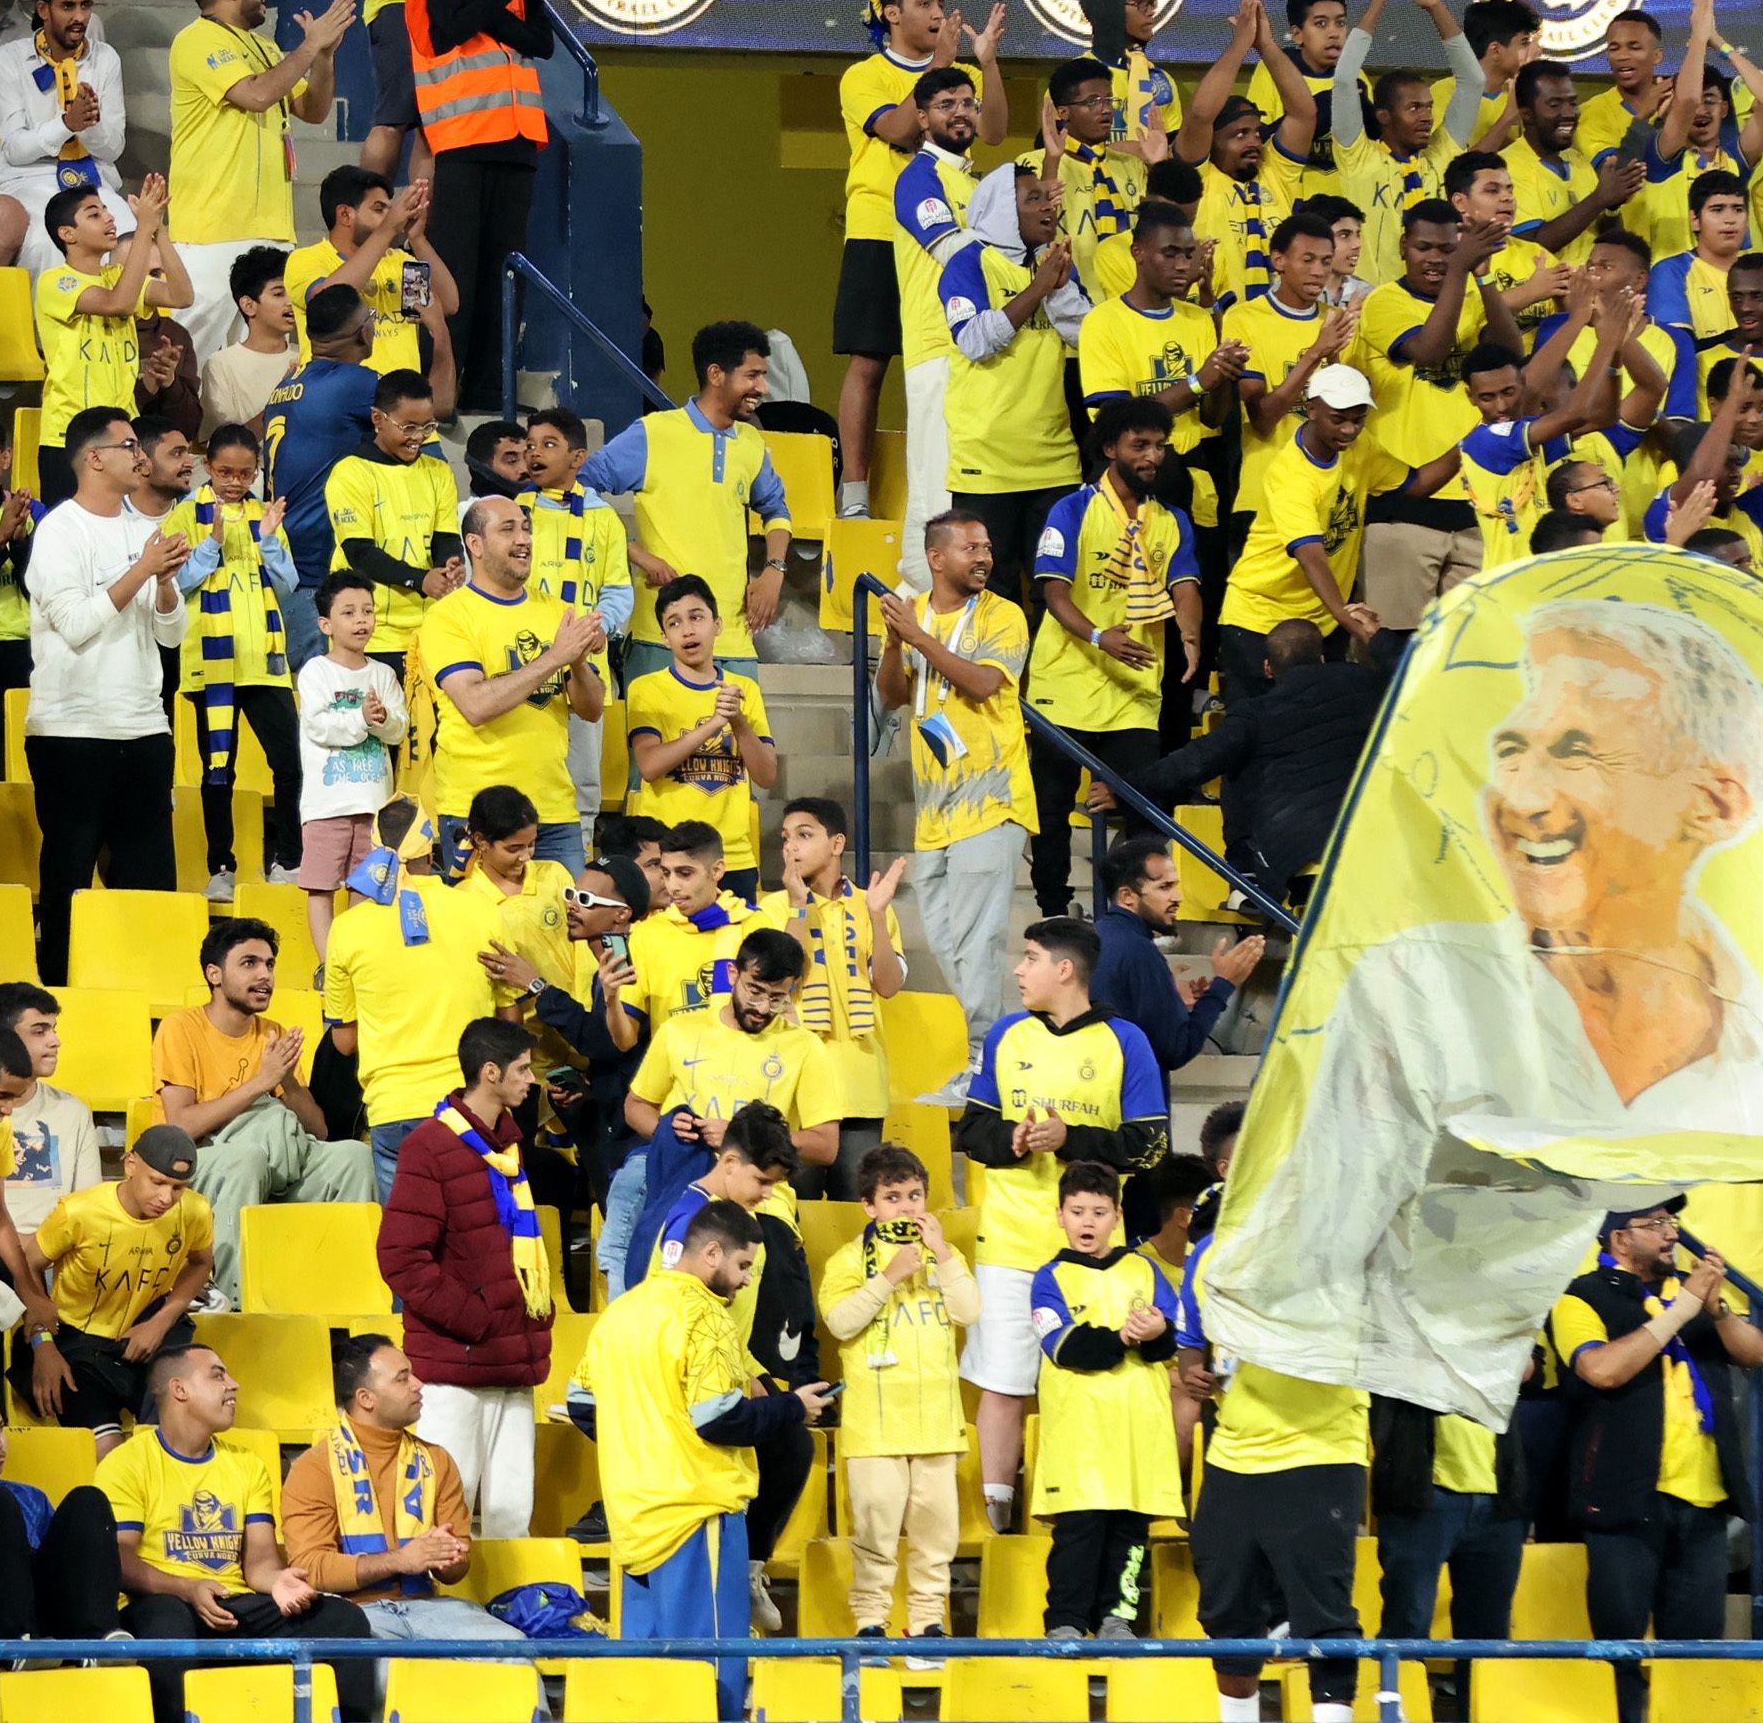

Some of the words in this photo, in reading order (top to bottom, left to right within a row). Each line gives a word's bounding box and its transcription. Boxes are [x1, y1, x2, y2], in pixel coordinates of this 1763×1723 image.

[81, 339, 137, 364] KAD
[1032, 1096, 1100, 1117] SHURFAH
[167, 1532, 210, 1552] YELLOW
[211, 1533, 243, 1552] KNIGHT
